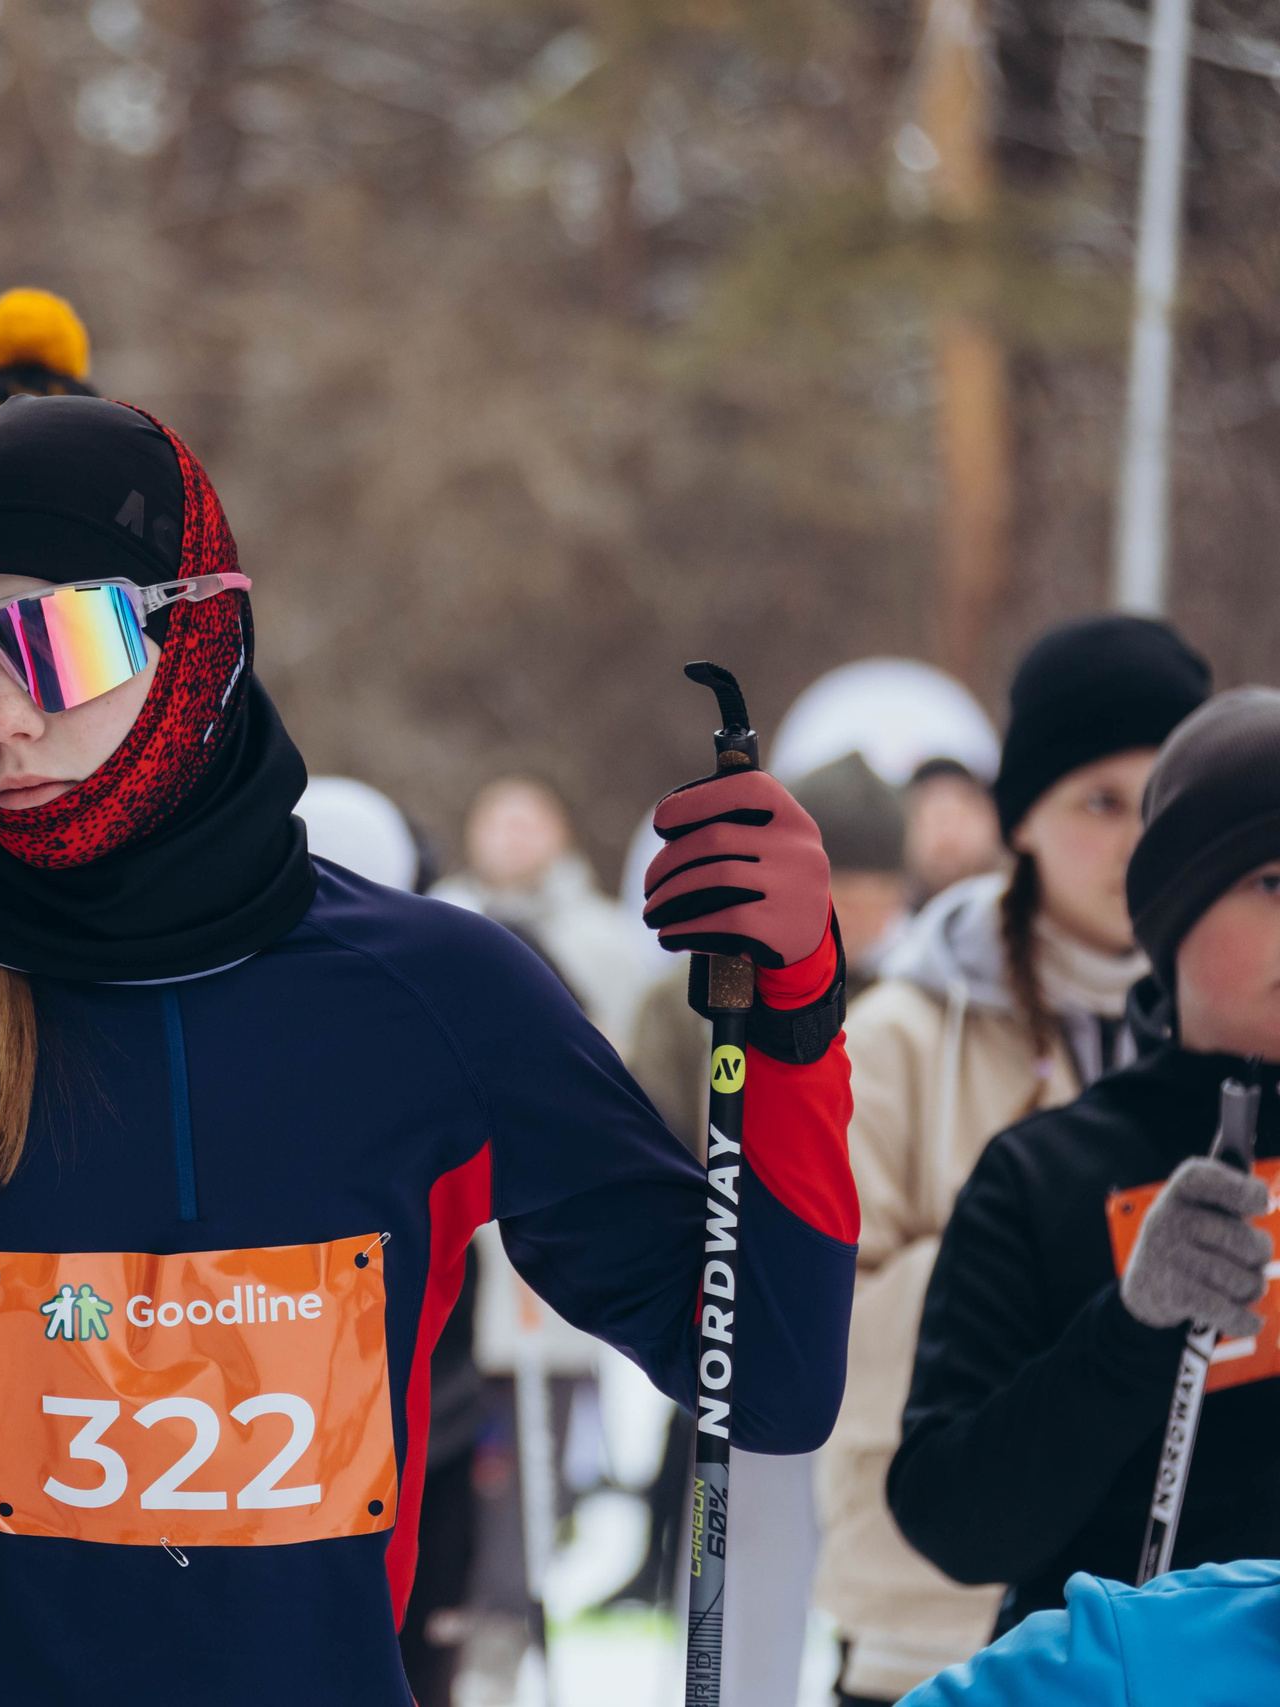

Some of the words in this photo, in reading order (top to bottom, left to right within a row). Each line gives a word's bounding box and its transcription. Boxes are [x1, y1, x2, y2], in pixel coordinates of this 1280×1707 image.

[125, 1284, 323, 1328] Goodline
[697, 1122, 742, 1440] NORDWAY
[41, 1392, 322, 1511] 322
[706, 1483, 729, 1561] 60%
